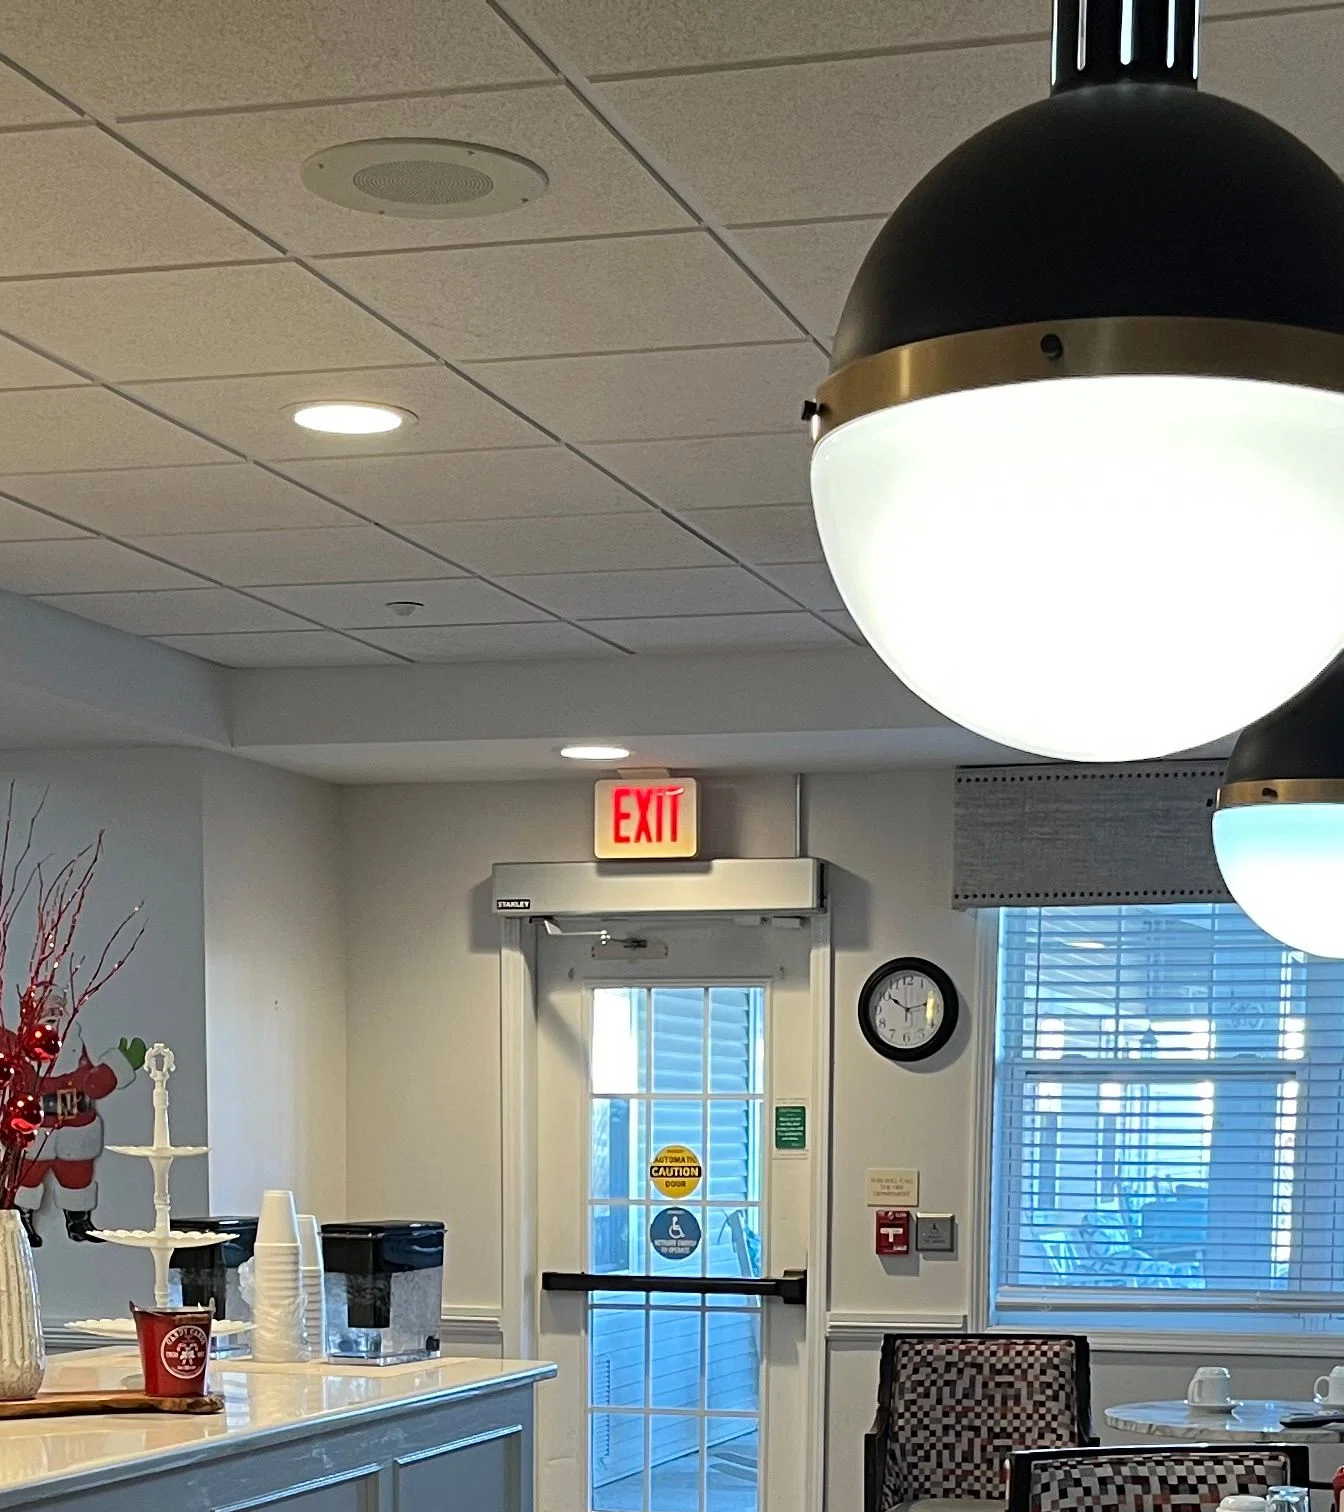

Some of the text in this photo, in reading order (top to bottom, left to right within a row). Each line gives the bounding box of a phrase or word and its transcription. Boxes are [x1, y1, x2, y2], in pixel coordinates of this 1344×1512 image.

[613, 785, 685, 844] EXIT
[902, 975, 914, 987] 12
[651, 1166, 699, 1177] CAUTION
